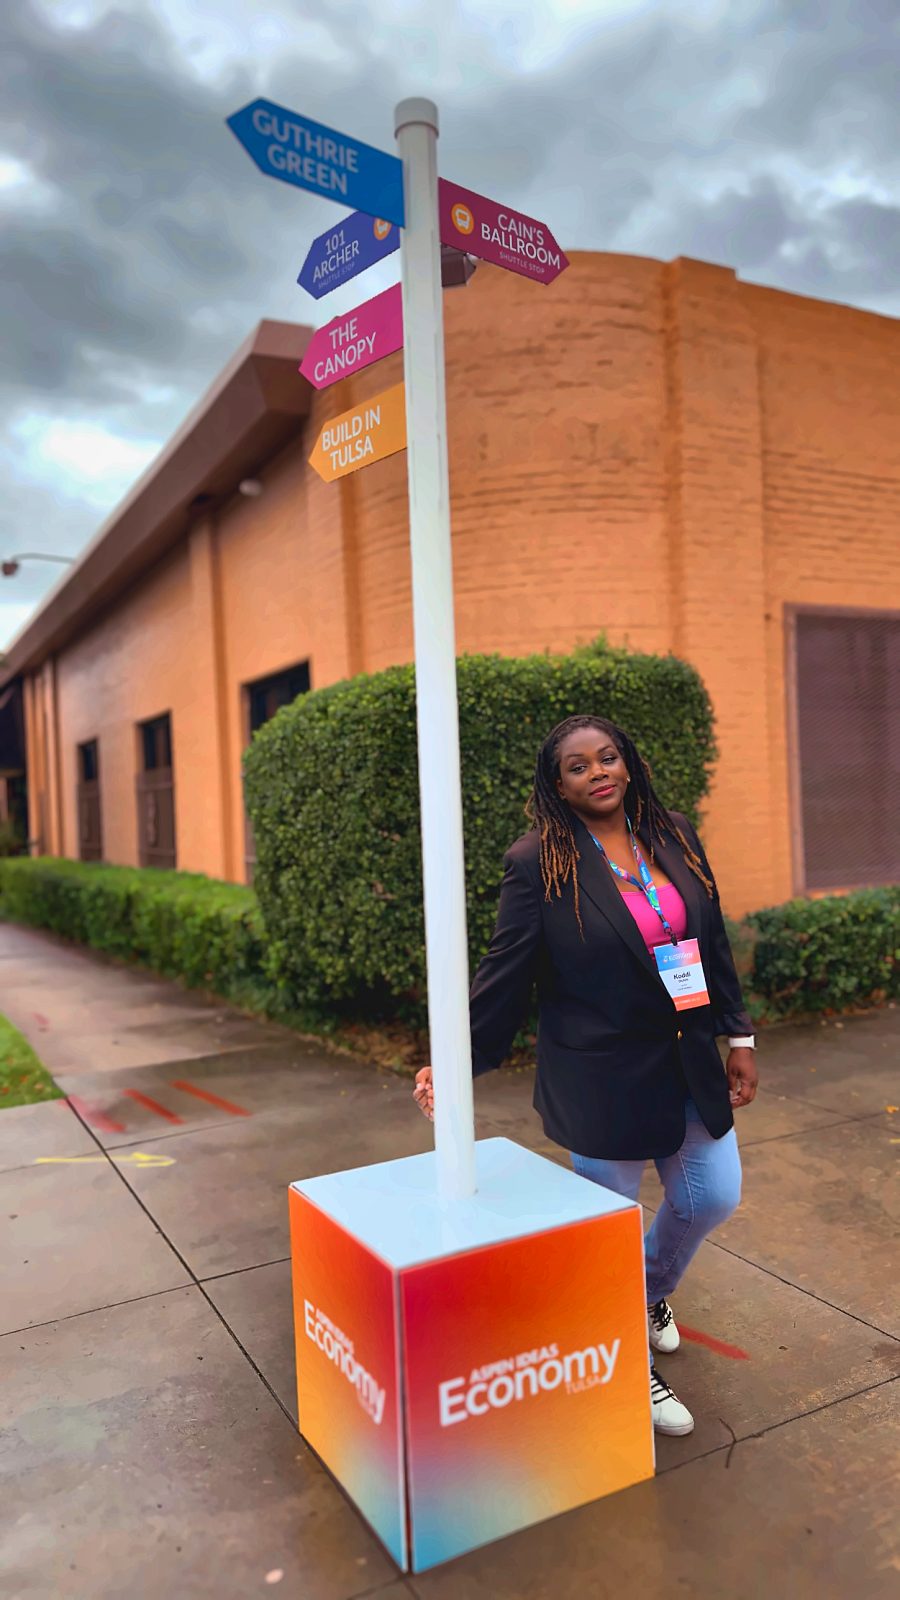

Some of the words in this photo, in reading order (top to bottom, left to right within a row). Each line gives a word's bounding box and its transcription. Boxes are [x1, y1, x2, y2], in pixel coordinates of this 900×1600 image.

[251, 108, 360, 174] GUTHRIE
[267, 143, 348, 196] GREEN
[325, 229, 346, 256] 101
[481, 222, 561, 270] BALLROOM
[497, 213, 545, 246] CAIN'S
[312, 239, 360, 283] ARCHER
[499, 251, 528, 269] SHUTTLE
[528, 261, 545, 274] STOP
[328, 317, 359, 349] THE
[313, 331, 378, 382] CANOPY
[321, 414, 364, 453] BUILD
[363, 404, 382, 431] IN
[329, 435, 374, 471] TULSA
[303, 1298, 387, 1425] Economy
[438, 1337, 621, 1428] Economy
[469, 1357, 515, 1384] ASPEN
[515, 1343, 560, 1369] IDEAS
[565, 1374, 603, 1395] TULSA
